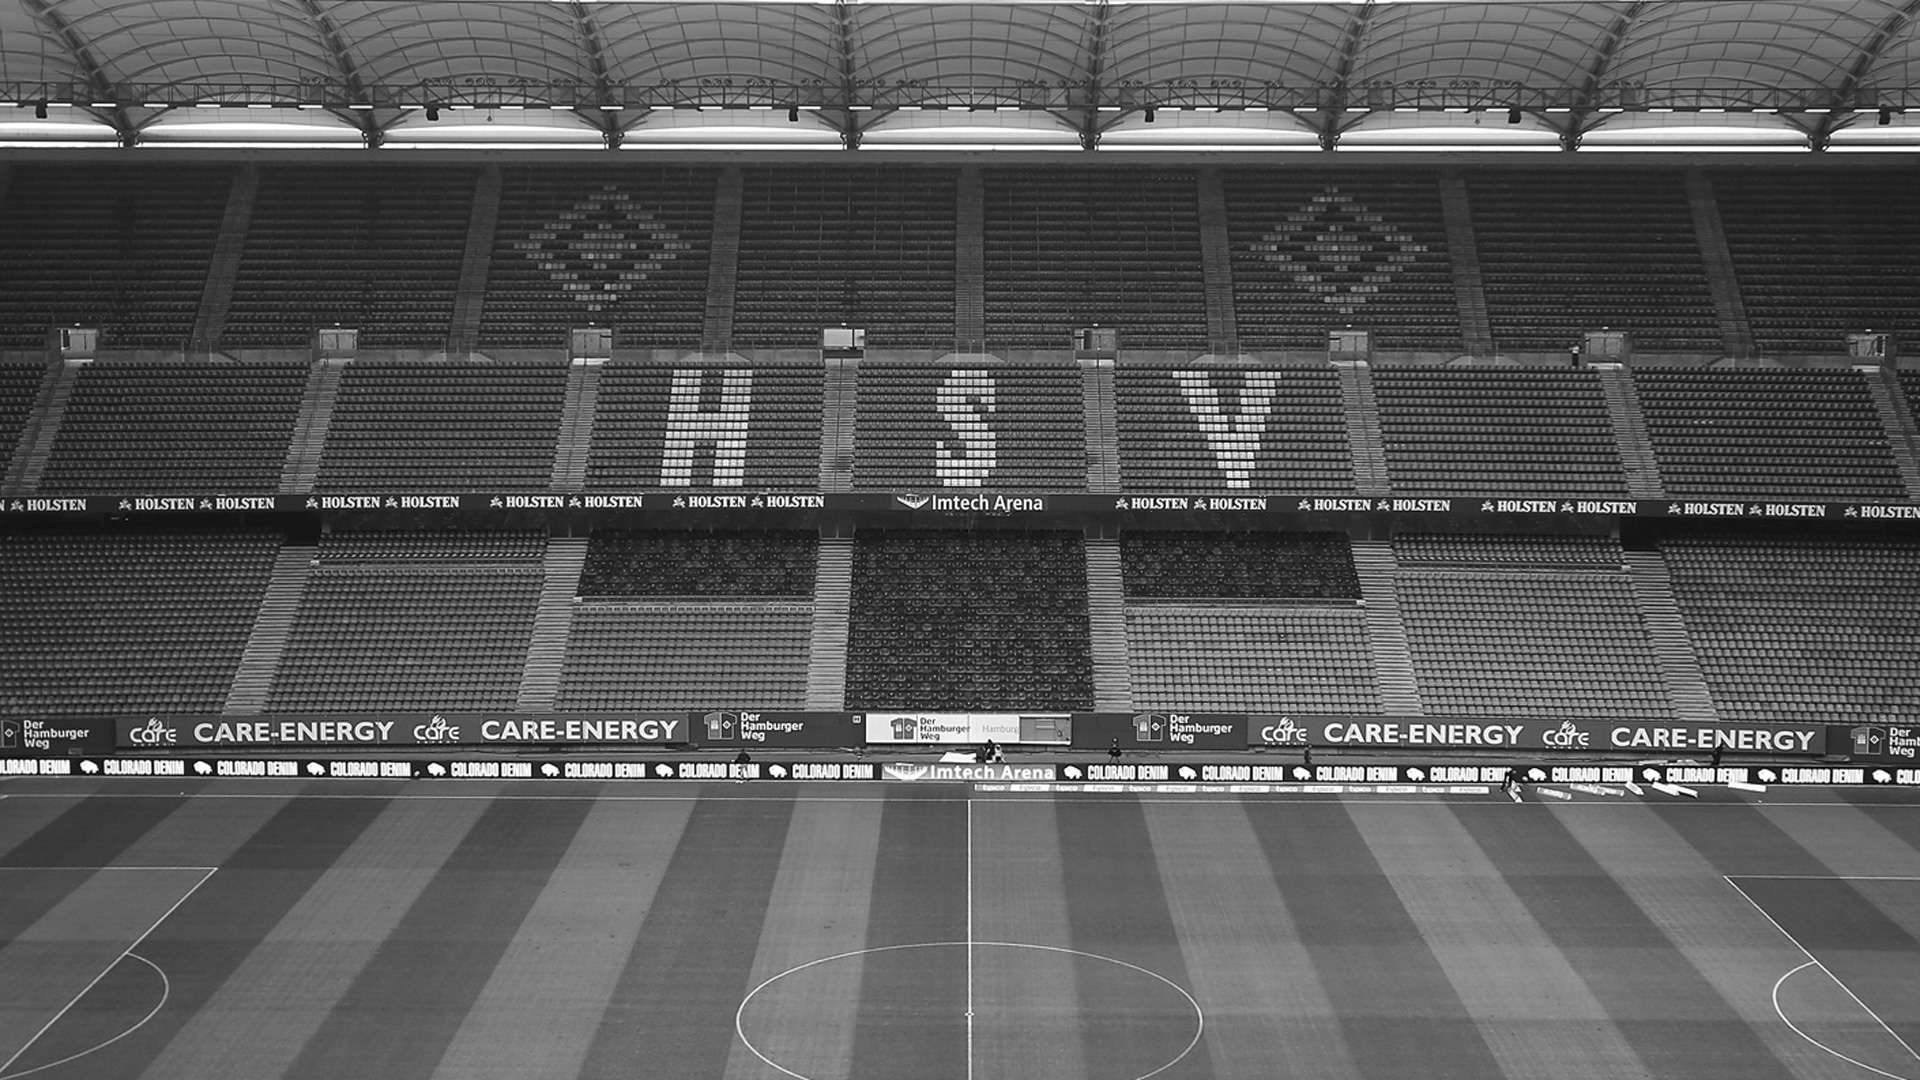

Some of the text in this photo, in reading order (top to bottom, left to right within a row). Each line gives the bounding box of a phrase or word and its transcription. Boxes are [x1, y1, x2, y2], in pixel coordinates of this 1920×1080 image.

[28, 499, 86, 511] HOLSTEN
[136, 498, 194, 510] HOLSTEN
[216, 498, 274, 510] HOLSTEN
[322, 497, 380, 508] HOLSTEN
[402, 497, 459, 508] HOLSTEN
[507, 496, 563, 508] HOLSTEN
[585, 496, 642, 508] HOLSTEN
[689, 496, 746, 508] HOLSTEN
[767, 496, 824, 508] HOLSTEN
[932, 494, 1044, 511] Imtech Arena
[1132, 498, 1188, 509] HOLSTEN
[1210, 498, 1266, 510] HOLSTEN
[1314, 499, 1371, 510] HOLSTEN
[1393, 500, 1450, 511] HOLSTEN
[1498, 501, 1556, 513] HOLSTEN
[1577, 501, 1636, 513] HOLSTEN
[1685, 503, 1744, 515] HOLSTEN
[1766, 504, 1825, 516] HOLSTEN
[1862, 506, 1920, 518] HOLSTEN
[741, 712, 760, 721] Der
[920, 717, 936, 725] Der
[1170, 714, 1190, 724] Der
[24, 720, 44, 729] Der
[481, 720, 678, 741] CARE-ENERGY
[741, 721, 804, 732] Hamburger
[920, 725, 970, 733] Hamburger
[1170, 723, 1233, 735] Hamburger
[24, 728, 89, 740] Hamburger
[194, 722, 394, 742] CARE-ENERGY
[741, 731, 765, 742] Weg
[920, 733, 940, 741] Weg
[1170, 732, 1194, 744] Weg
[1324, 722, 1524, 744] CARE-ENERGY
[1611, 726, 1815, 750] CARE-ENERGY
[1890, 727, 1911, 737] Der
[24, 738, 50, 750] Weg
[1890, 746, 1915, 758] Weg
[0, 760, 70, 774] LORADO DENIM
[104, 760, 184, 775] COLORADO DENIM
[217, 761, 298, 775] COLORADO DENIM
[331, 762, 411, 776] COLORADO DENIM
[451, 763, 531, 776] COLORADO DENIM
[565, 763, 645, 777] COLORADO DENIM
[679, 764, 727, 777] COLORADO
[793, 765, 873, 778] COLORADO DENIM
[931, 765, 1054, 780] Imtech Arena
[1088, 766, 1168, 780] COLORADO DENIM
[1202, 767, 1283, 780] COLORADO DENIM
[1317, 767, 1397, 781] COLORADO DENIM
[1430, 767, 1478, 781] COLORADO
[1552, 768, 1633, 782] COLORADO DENIM
[1666, 768, 1715, 782] COLORADO
[1782, 769, 1863, 783] COLORADO DENIM
